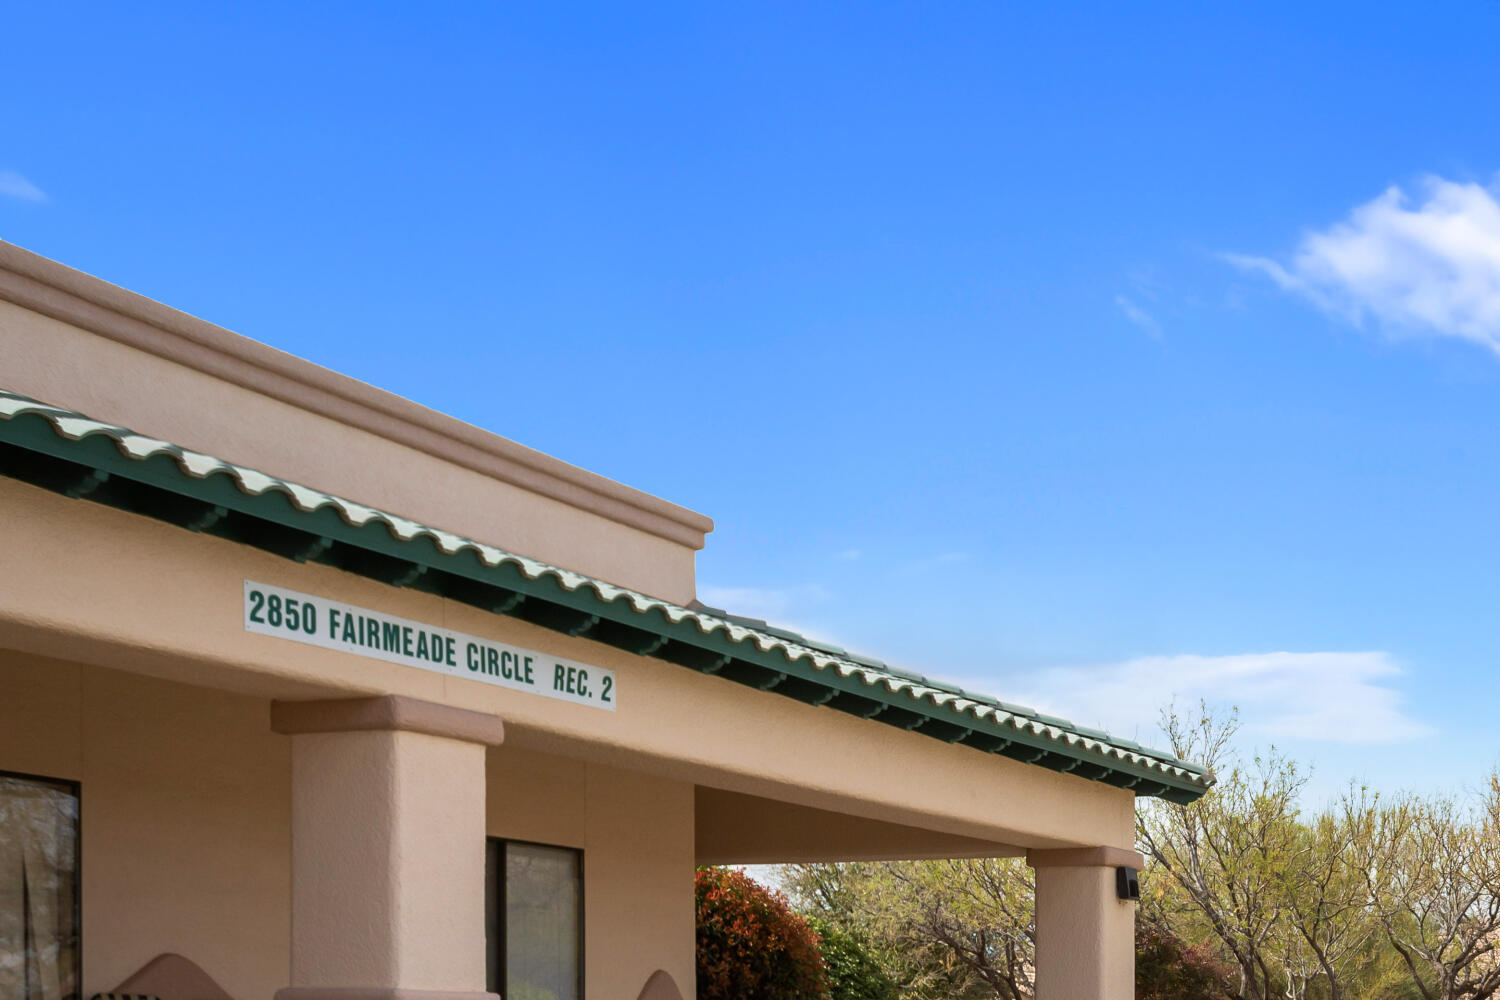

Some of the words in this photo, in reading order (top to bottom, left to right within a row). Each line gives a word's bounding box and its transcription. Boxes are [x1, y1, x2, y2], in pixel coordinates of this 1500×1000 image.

[249, 589, 317, 635] 2850
[328, 607, 457, 667] FAIRMEADE
[466, 641, 535, 685] CIRCLE
[553, 663, 593, 698] REC.
[600, 675, 613, 703] 2
